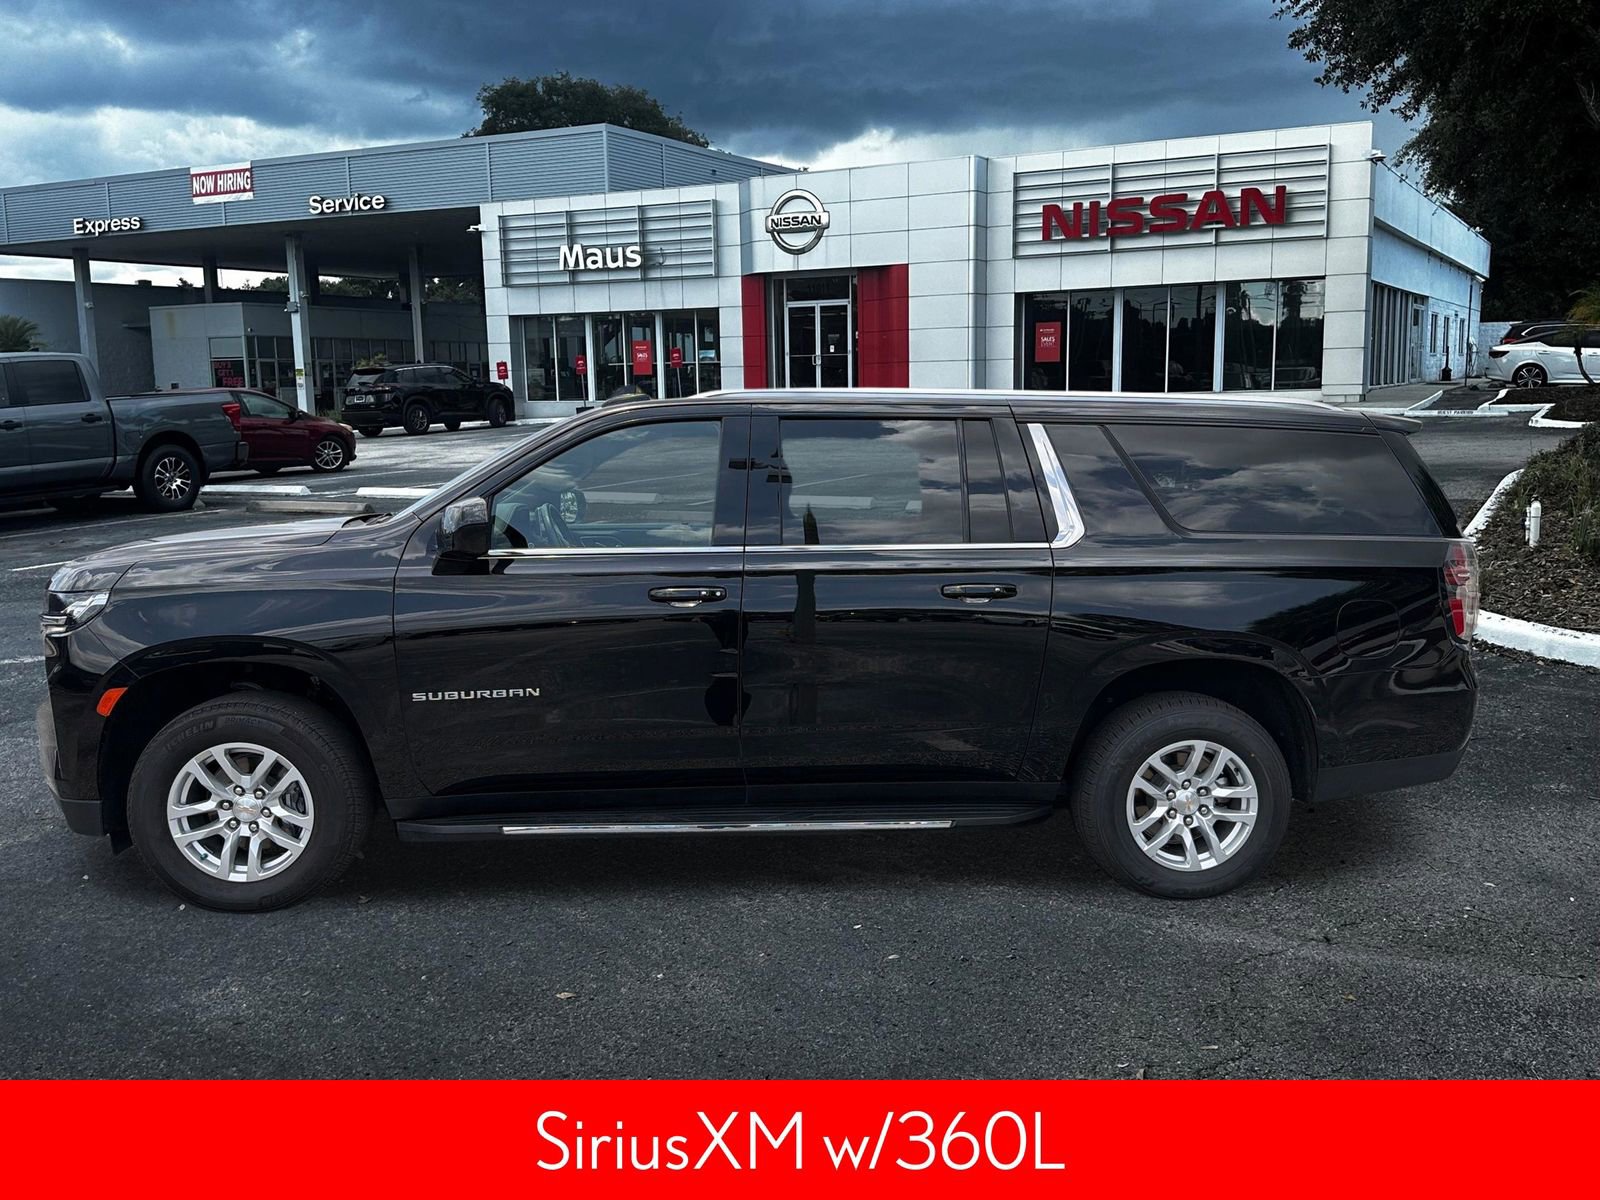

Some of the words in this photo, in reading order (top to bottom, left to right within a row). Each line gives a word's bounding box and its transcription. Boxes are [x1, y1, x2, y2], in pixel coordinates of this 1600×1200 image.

[192, 174, 214, 195] NOW
[217, 171, 251, 193] HIRING
[309, 193, 385, 215] Service
[1042, 185, 1287, 241] NISSAN
[73, 215, 141, 237] Express
[770, 215, 822, 228] NISSAN
[559, 243, 642, 271] Maus
[222, 377, 244, 386] FREE
[412, 688, 540, 701] SUBURBAN
